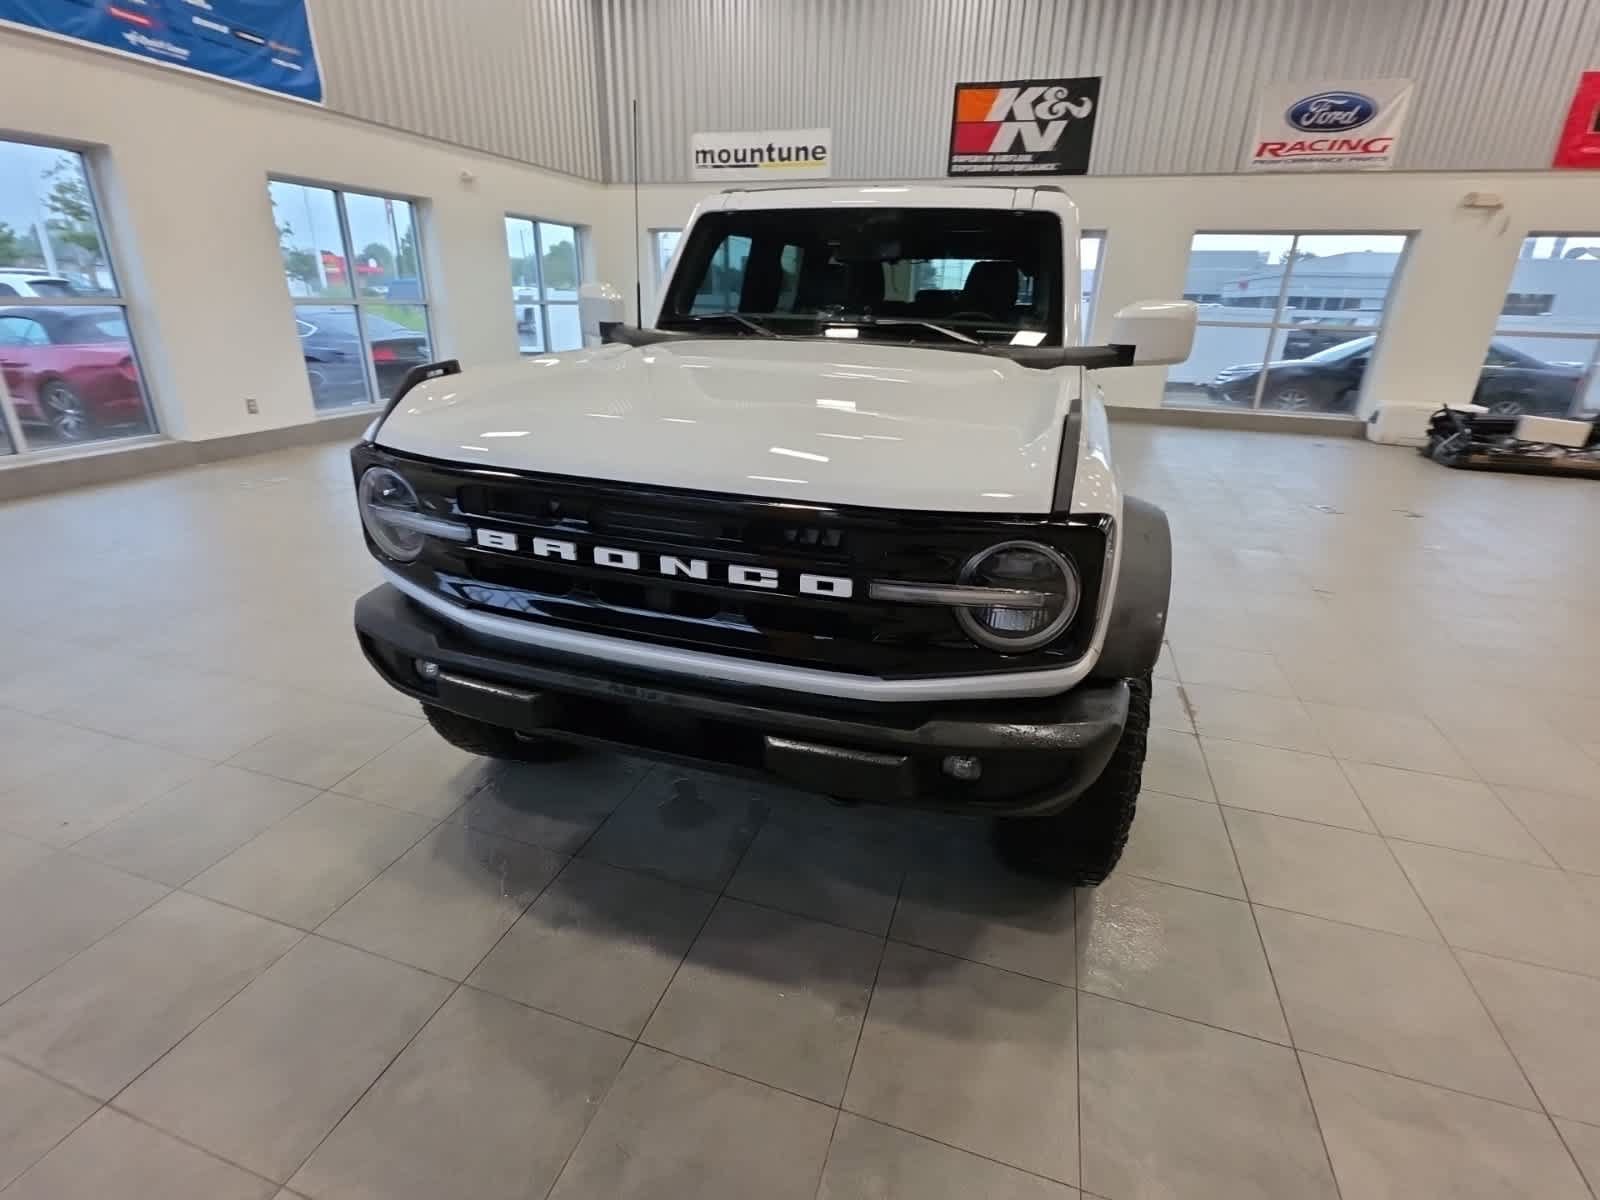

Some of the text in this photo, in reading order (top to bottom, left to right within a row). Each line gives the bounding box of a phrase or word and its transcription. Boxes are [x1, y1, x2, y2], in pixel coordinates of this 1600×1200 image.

[1301, 98, 1362, 127] Ford
[695, 142, 827, 165] mountune
[1255, 137, 1393, 157] RACING
[475, 527, 854, 599] BRONCO
